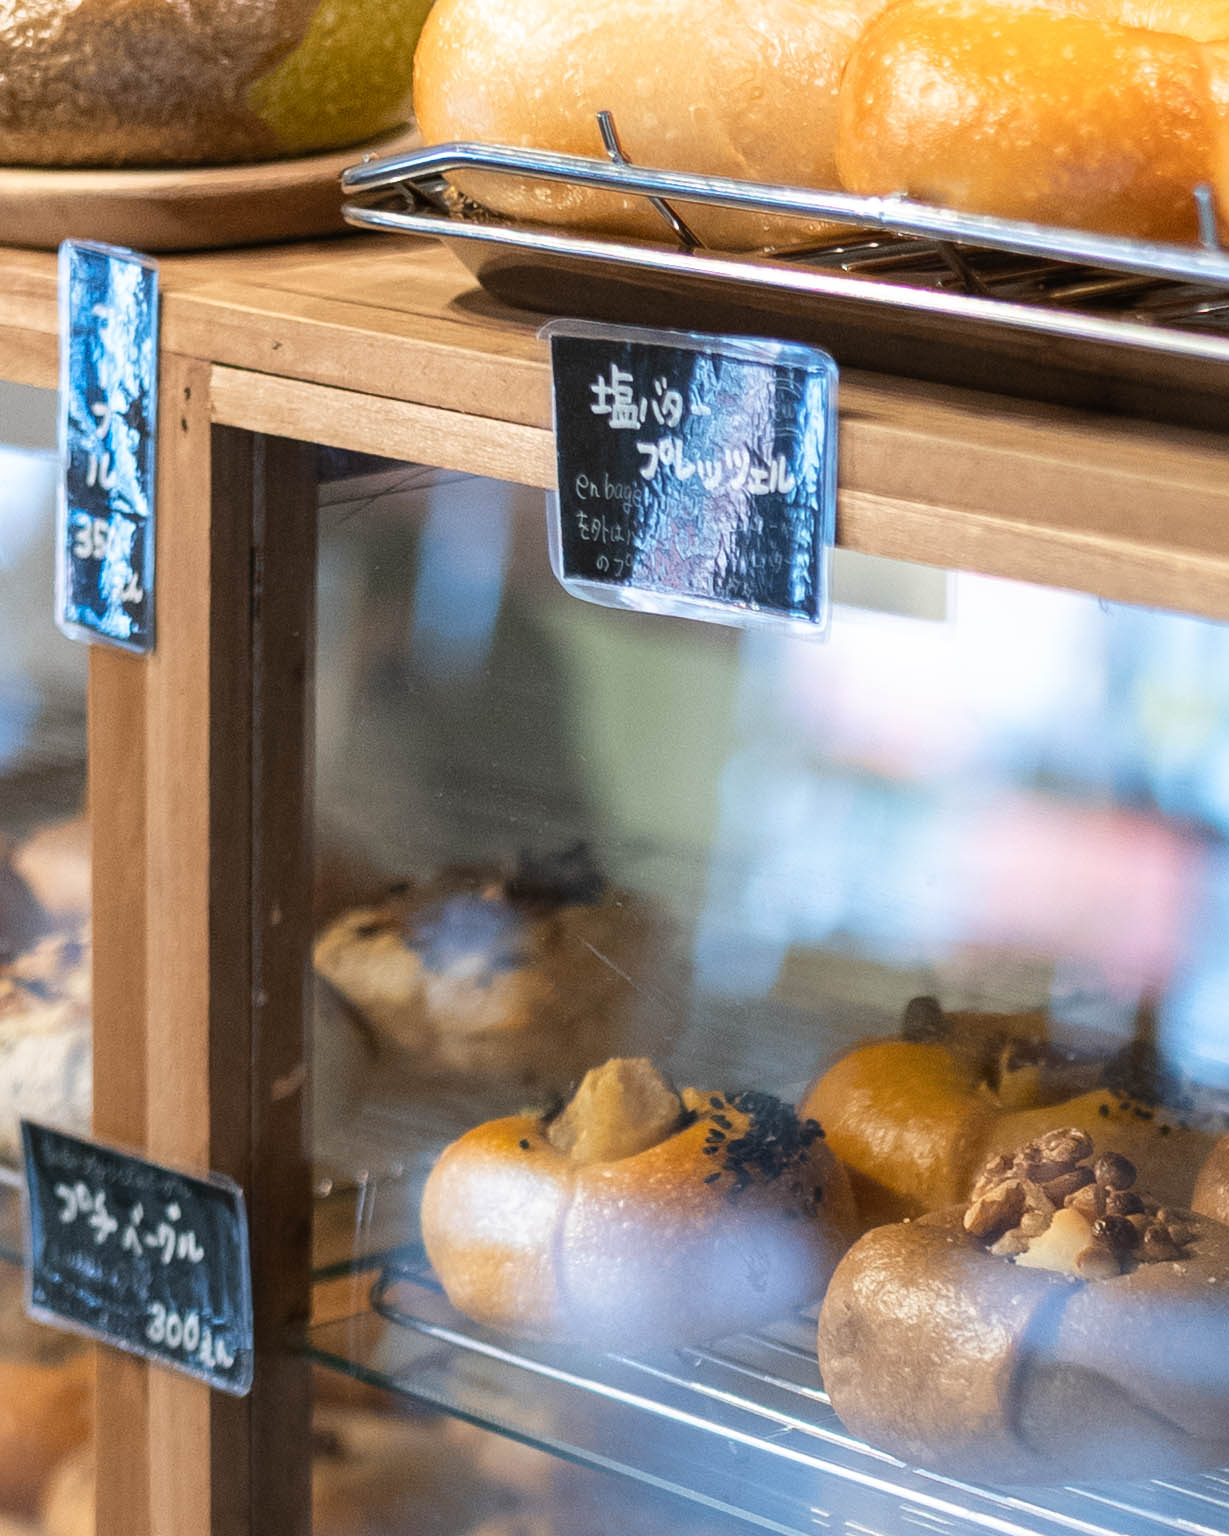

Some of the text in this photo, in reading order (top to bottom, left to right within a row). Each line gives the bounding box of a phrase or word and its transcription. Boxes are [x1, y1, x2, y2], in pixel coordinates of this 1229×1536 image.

[589, 363, 711, 429] 塩バター
[575, 472, 644, 513] en bage
[636, 434, 795, 495] プレッツェル
[146, 1302, 235, 1369] 300えん
